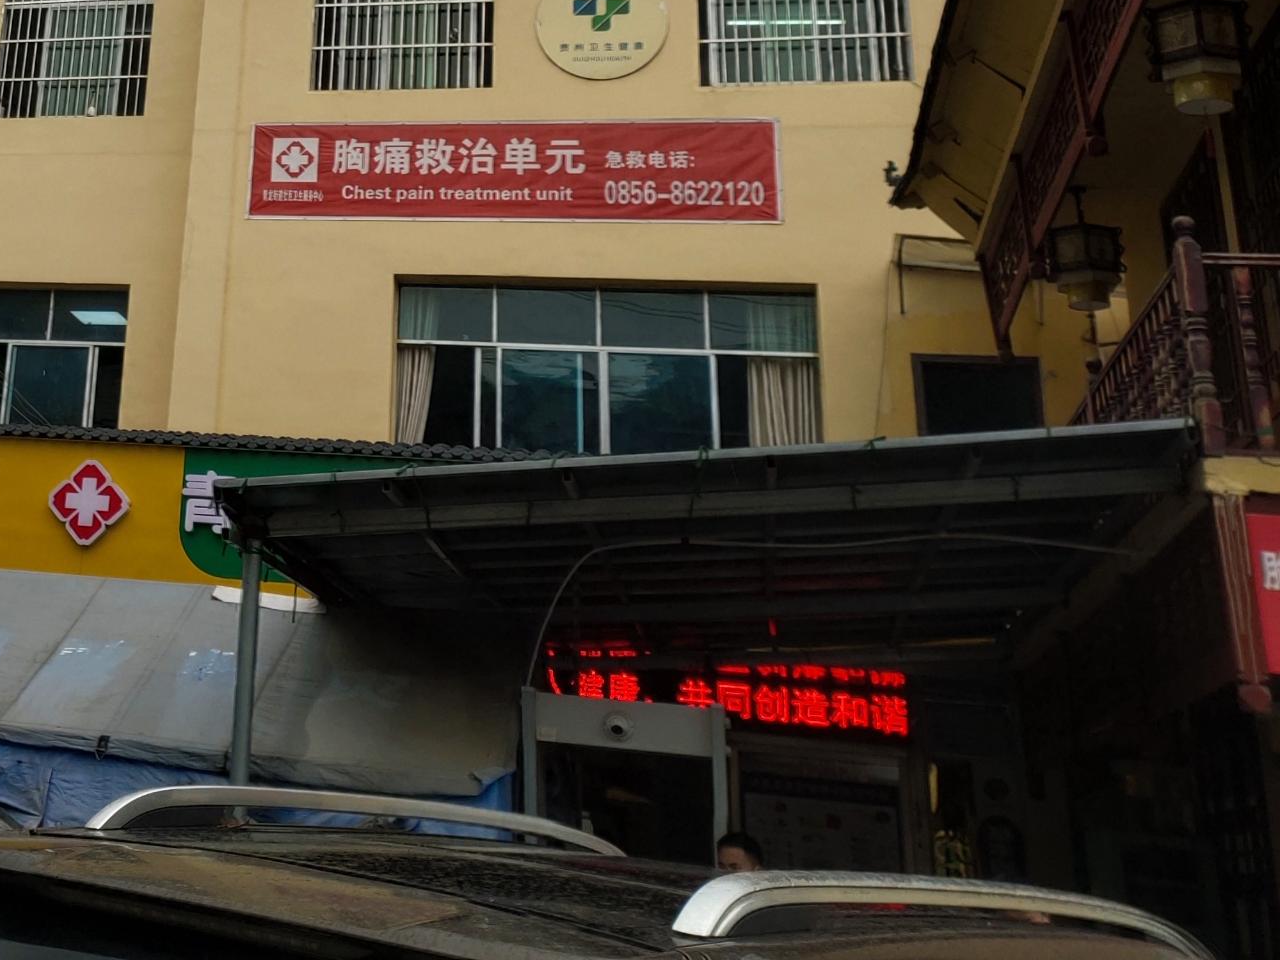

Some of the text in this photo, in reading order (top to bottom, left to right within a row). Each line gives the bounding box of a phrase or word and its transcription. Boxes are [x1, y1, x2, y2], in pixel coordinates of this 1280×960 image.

[332, 137, 587, 176] 胸痛救治单元
[341, 184, 573, 204] Chest pain treatment unit
[604, 180, 765, 207] 0856-8622120
